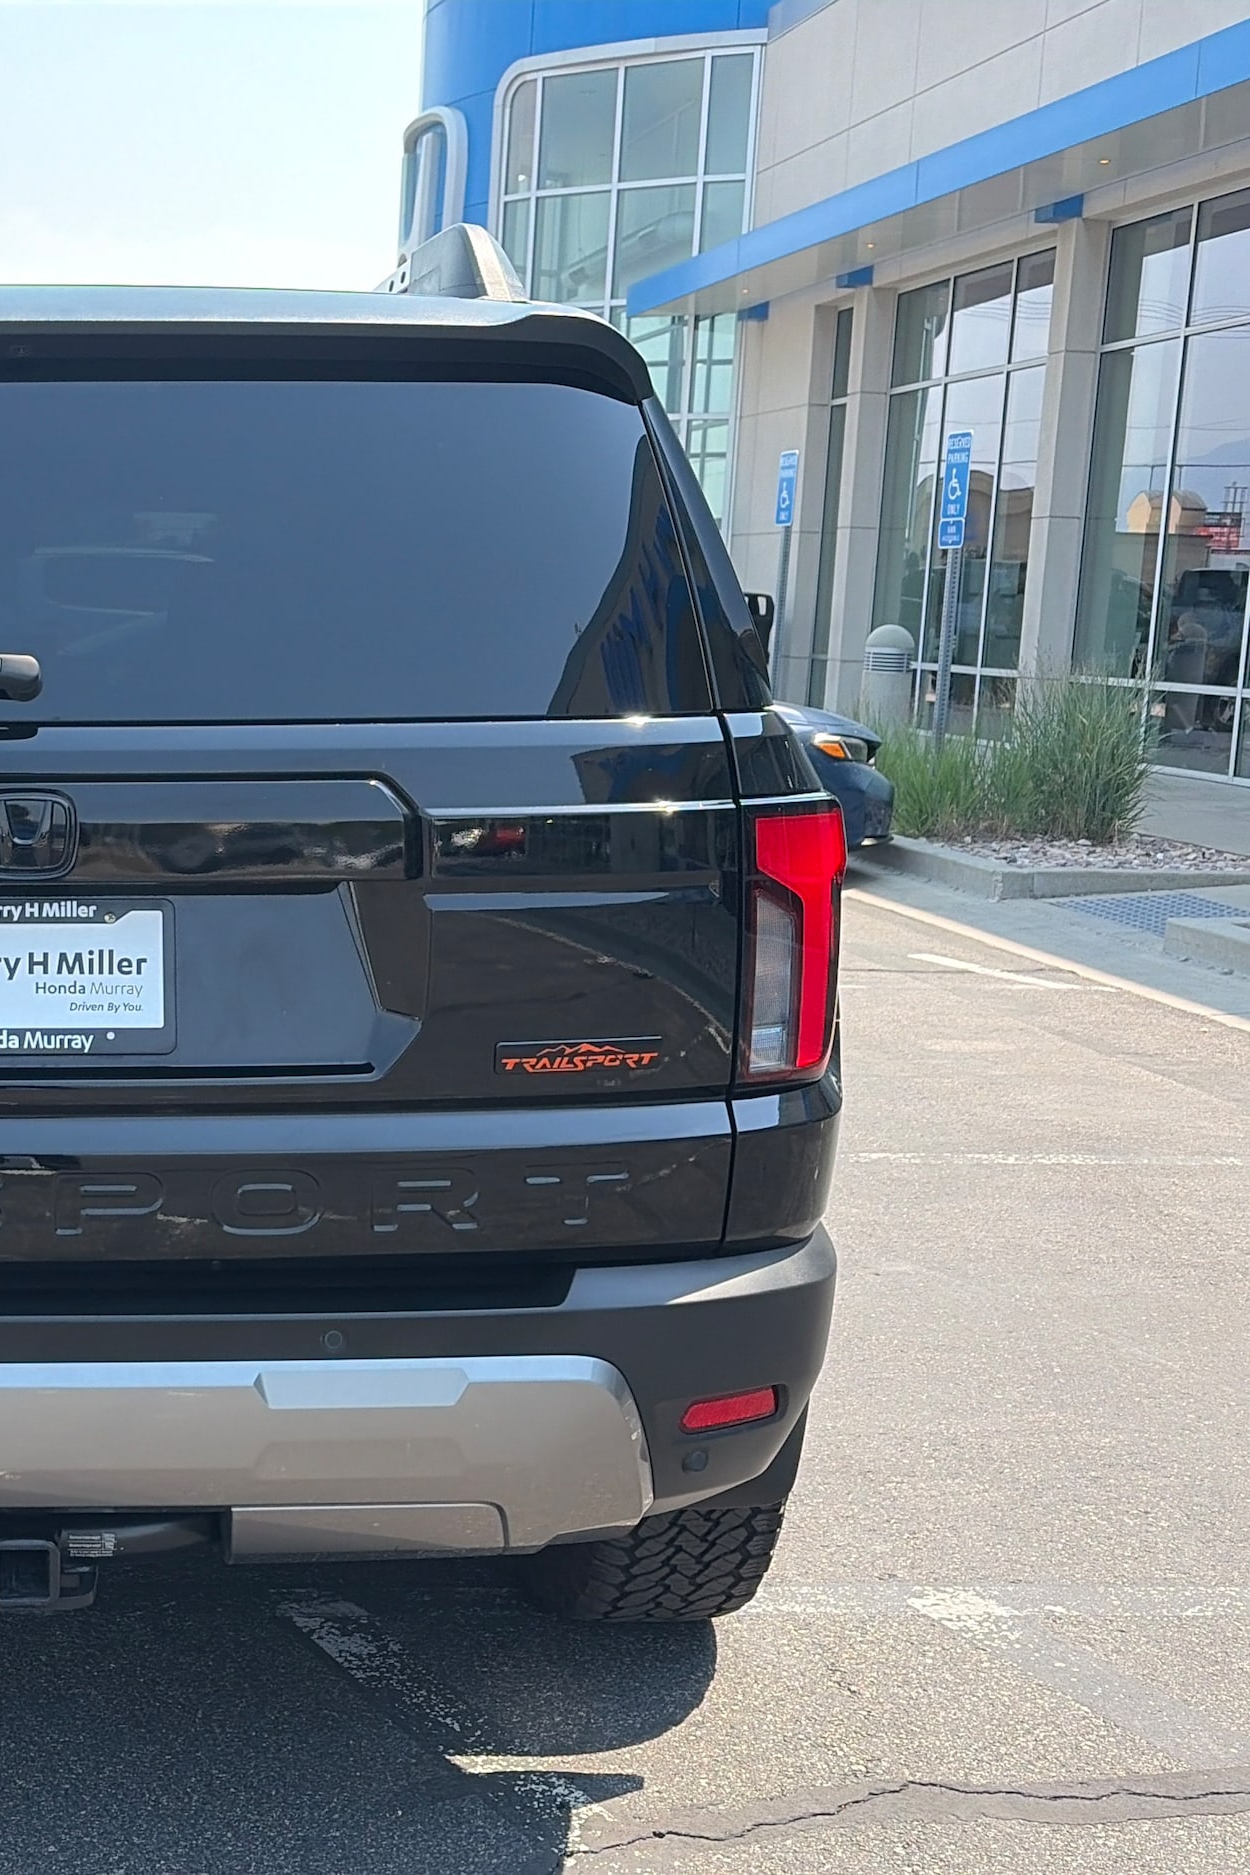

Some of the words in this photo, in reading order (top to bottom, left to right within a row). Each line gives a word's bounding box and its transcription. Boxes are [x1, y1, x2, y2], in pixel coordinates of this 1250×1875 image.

[948, 451, 969, 464] PARKING
[25, 902, 39, 918] H
[42, 900, 97, 918] Miller
[28, 951, 49, 975] H
[57, 949, 148, 976] Miller
[35, 980, 86, 995] Honda
[90, 982, 143, 997] Murray
[69, 1001, 104, 1012] Driven
[107, 1001, 121, 1013] By
[23, 1031, 94, 1053] Murray
[501, 1052, 659, 1073] TRAILSPORT
